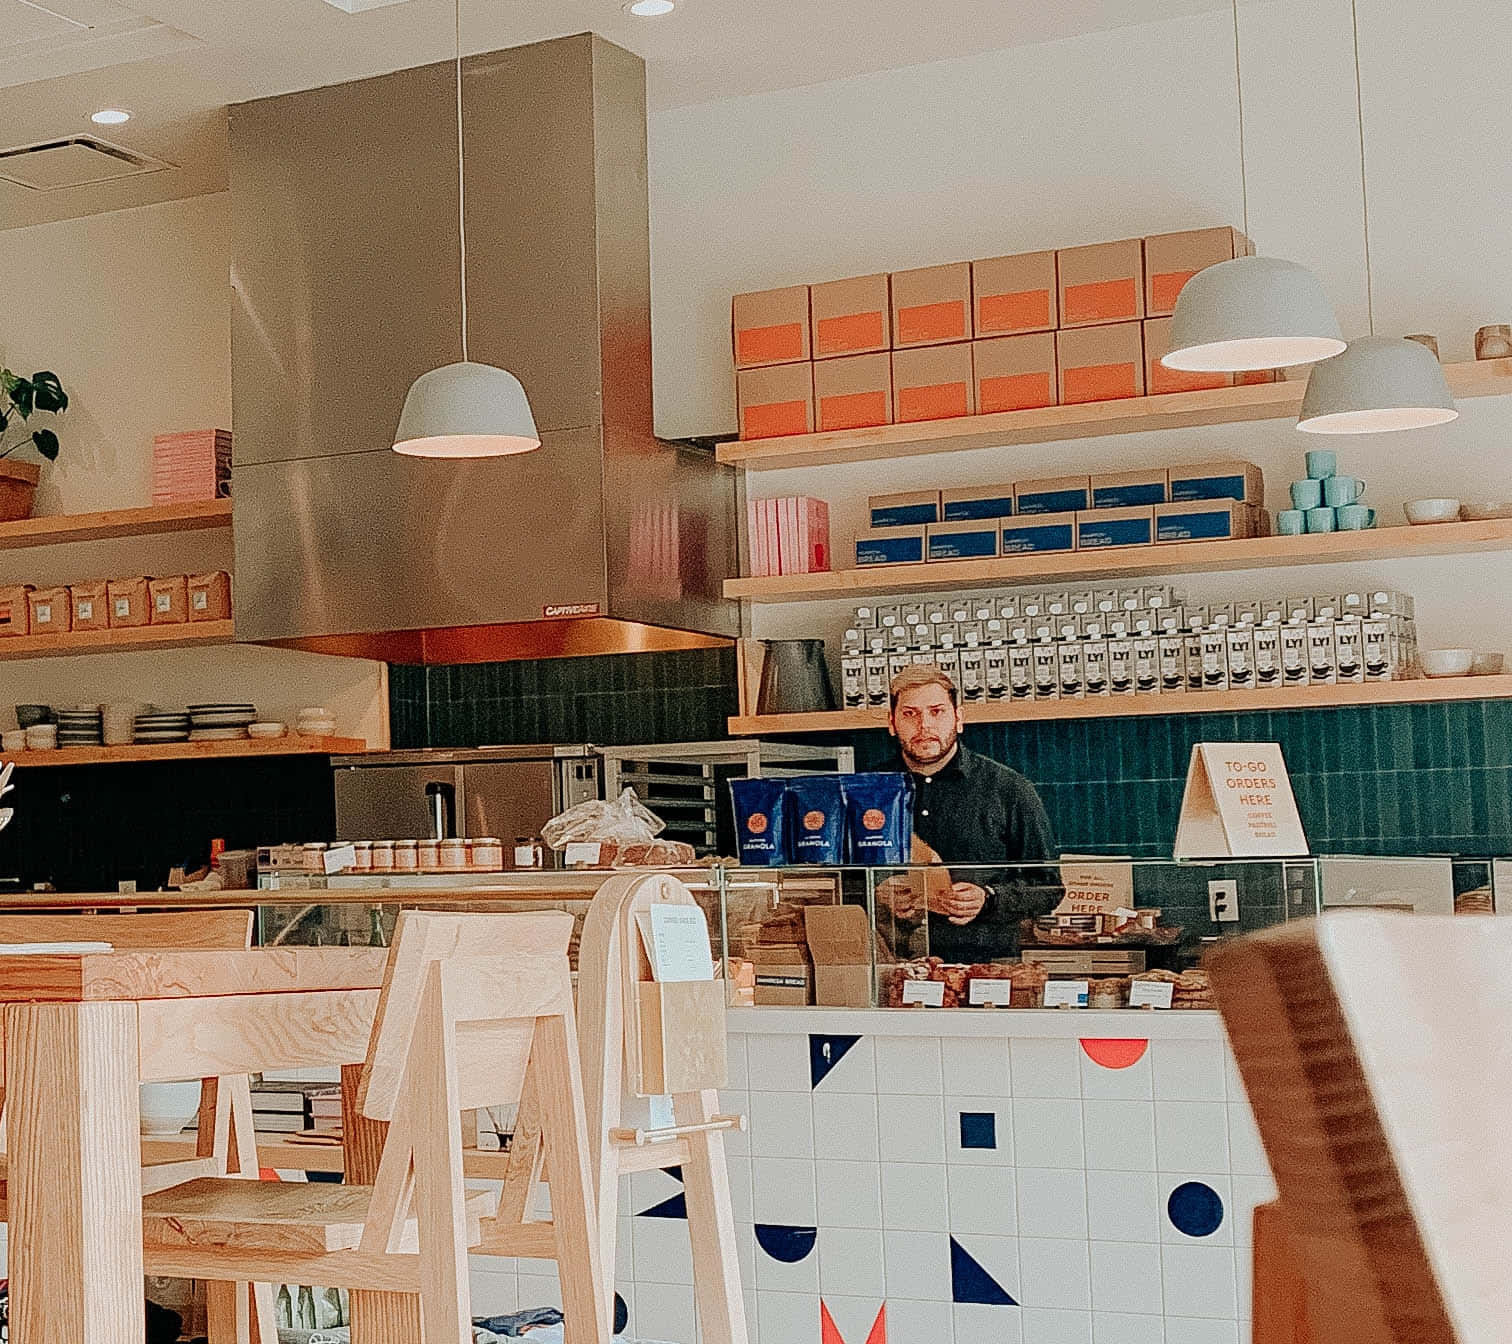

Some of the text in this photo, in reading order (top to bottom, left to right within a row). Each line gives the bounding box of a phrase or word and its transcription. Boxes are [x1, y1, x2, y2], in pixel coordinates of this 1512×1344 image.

[1190, 647, 1201, 656] LY
[1225, 761, 1266, 772] TO-GO
[1226, 778, 1276, 789] ORDERS
[1240, 795, 1272, 805] HERE
[1067, 891, 1110, 901] ORDER
[1072, 904, 1104, 913] HERE
